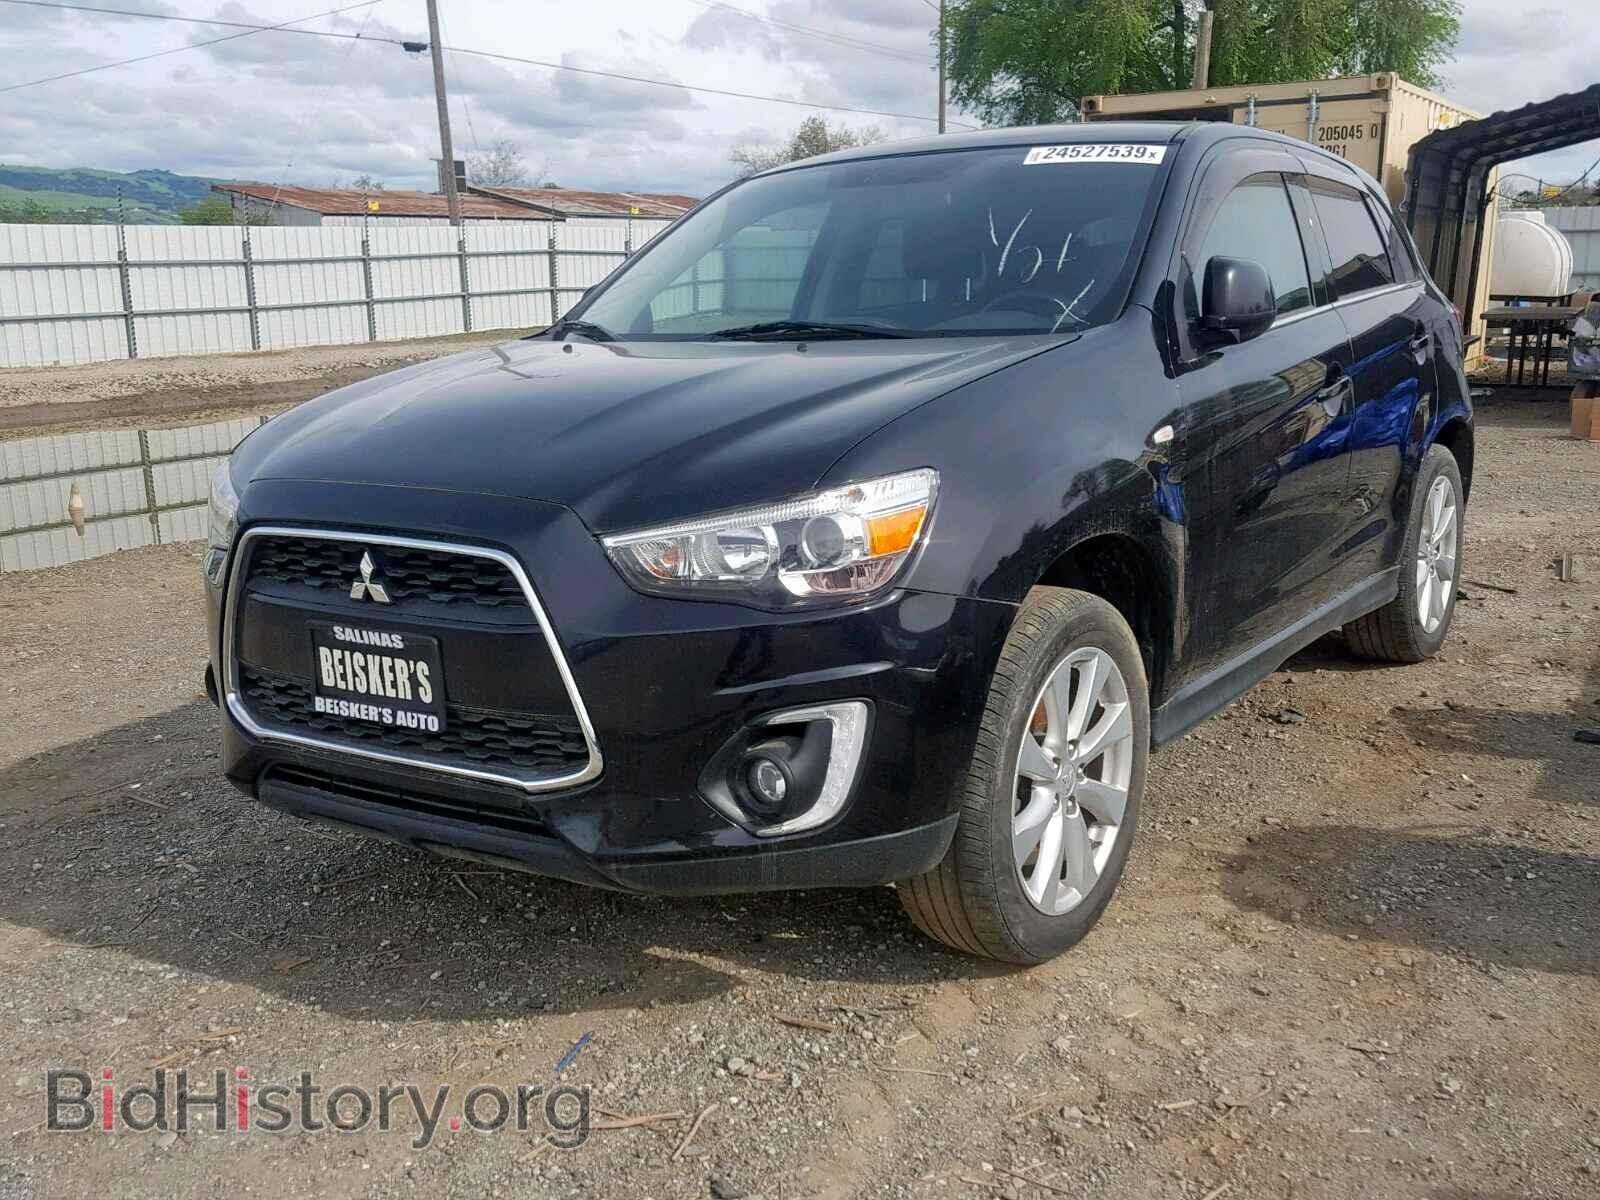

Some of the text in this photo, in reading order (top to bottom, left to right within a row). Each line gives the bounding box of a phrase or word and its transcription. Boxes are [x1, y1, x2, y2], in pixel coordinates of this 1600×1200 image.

[1318, 124, 1364, 142] 205045
[333, 625, 404, 649] SALINAS
[319, 646, 433, 704] BEISKER'S
[314, 696, 439, 732] BEISKER'S AUTO
